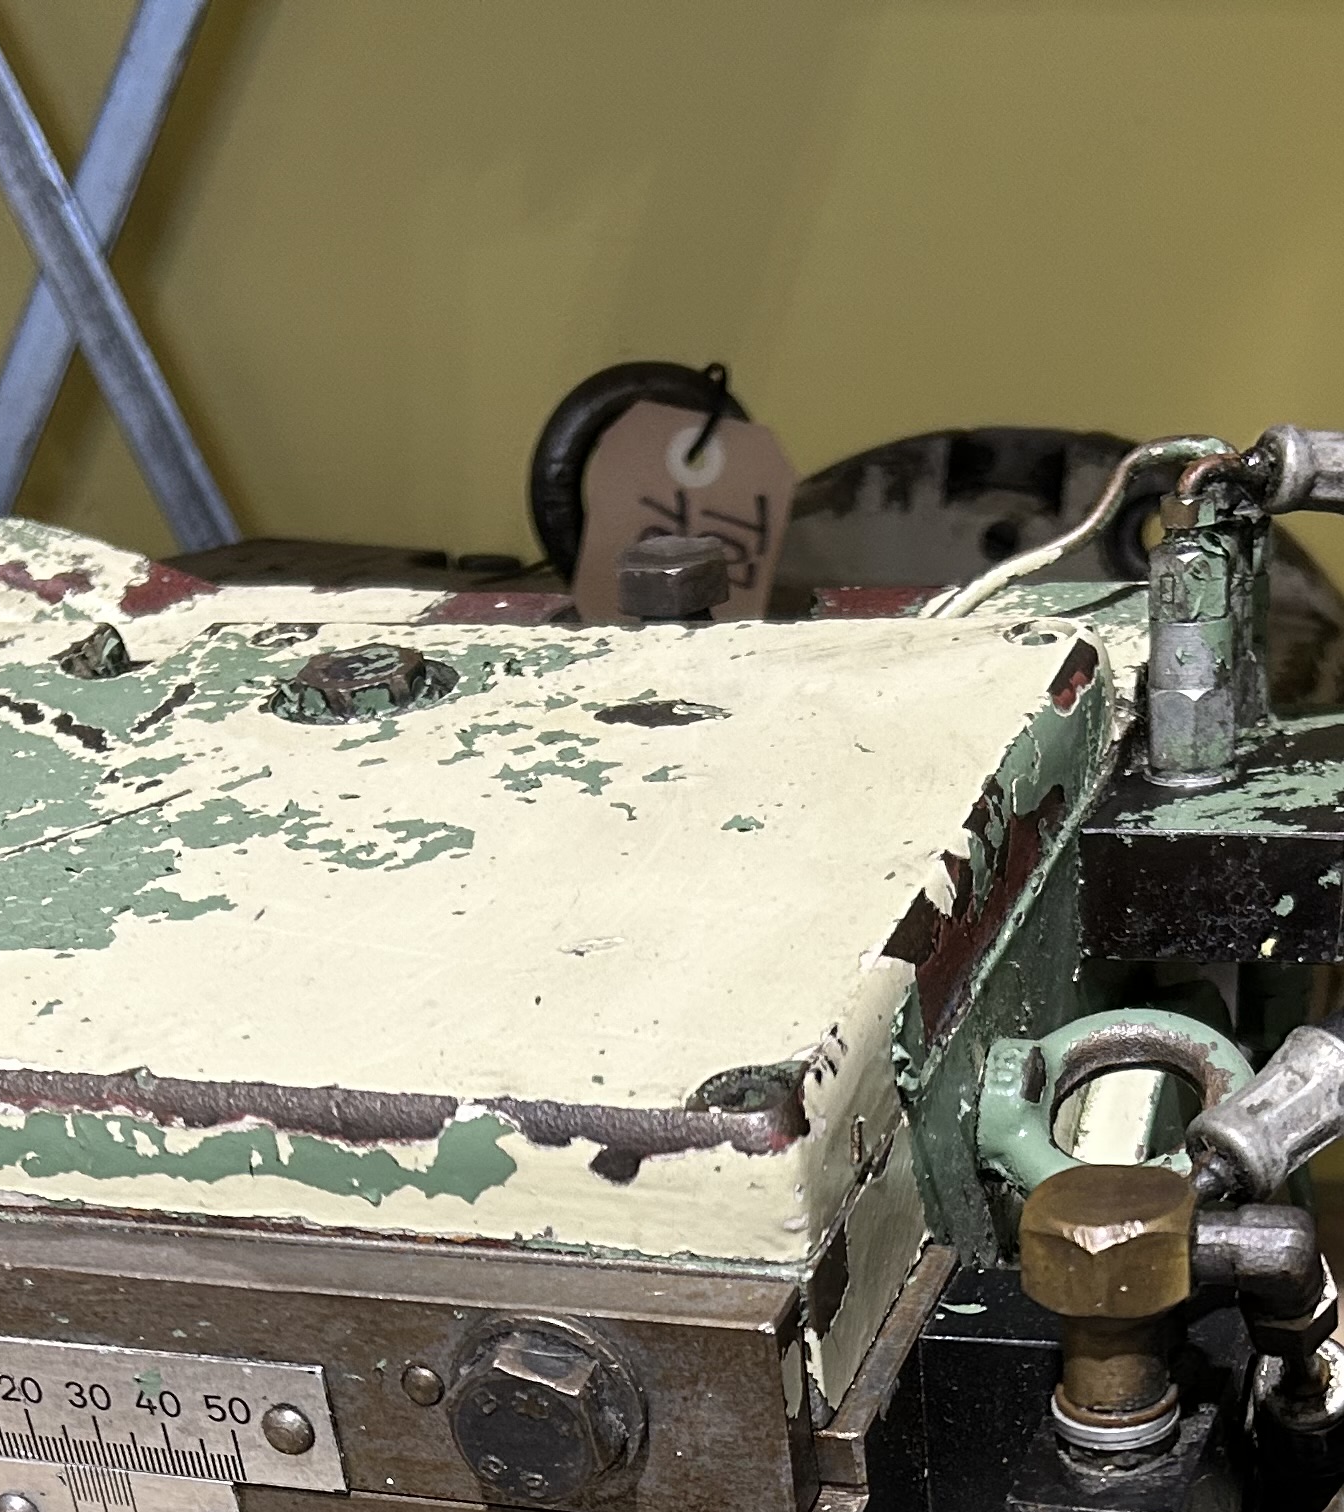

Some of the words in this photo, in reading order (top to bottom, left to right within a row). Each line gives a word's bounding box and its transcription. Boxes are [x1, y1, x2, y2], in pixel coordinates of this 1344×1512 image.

[63, 1381, 113, 1412] 30
[134, 1388, 183, 1419] 40
[202, 1394, 253, 1426] 50
